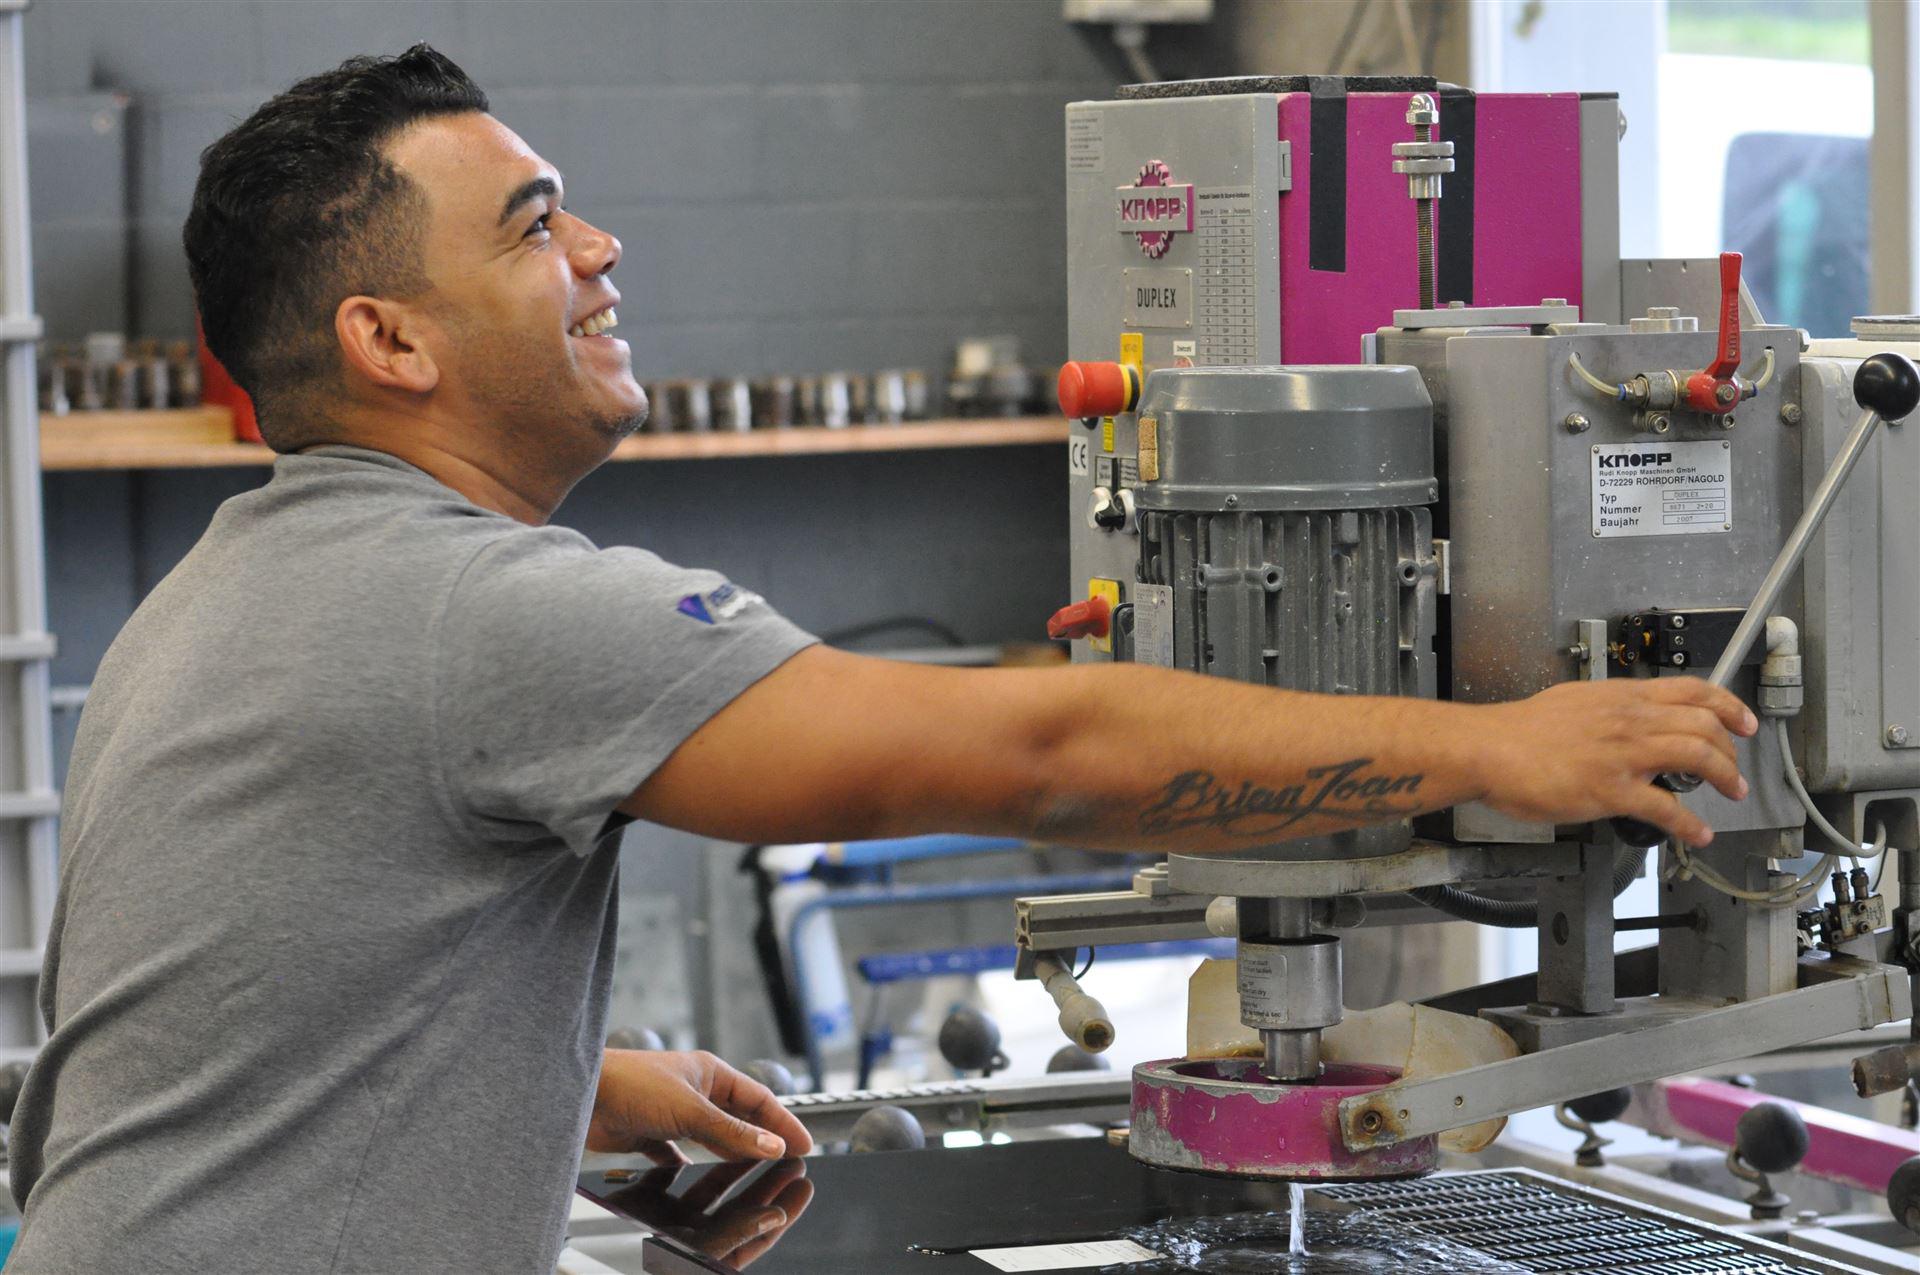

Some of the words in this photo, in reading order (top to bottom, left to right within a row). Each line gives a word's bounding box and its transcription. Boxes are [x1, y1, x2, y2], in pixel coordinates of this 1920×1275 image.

[1121, 197, 1181, 220] KNOPP
[1137, 288, 1176, 308] DUPLEX
[1599, 453, 1672, 468] KNOPP
[1677, 466, 1697, 474] GmbH
[1600, 479, 1634, 487] D-72229
[1600, 493, 1617, 504] Typ
[1600, 506, 1642, 515] Nummer
[1600, 518, 1640, 528] Baujahr
[1146, 768, 1305, 815] Brian
